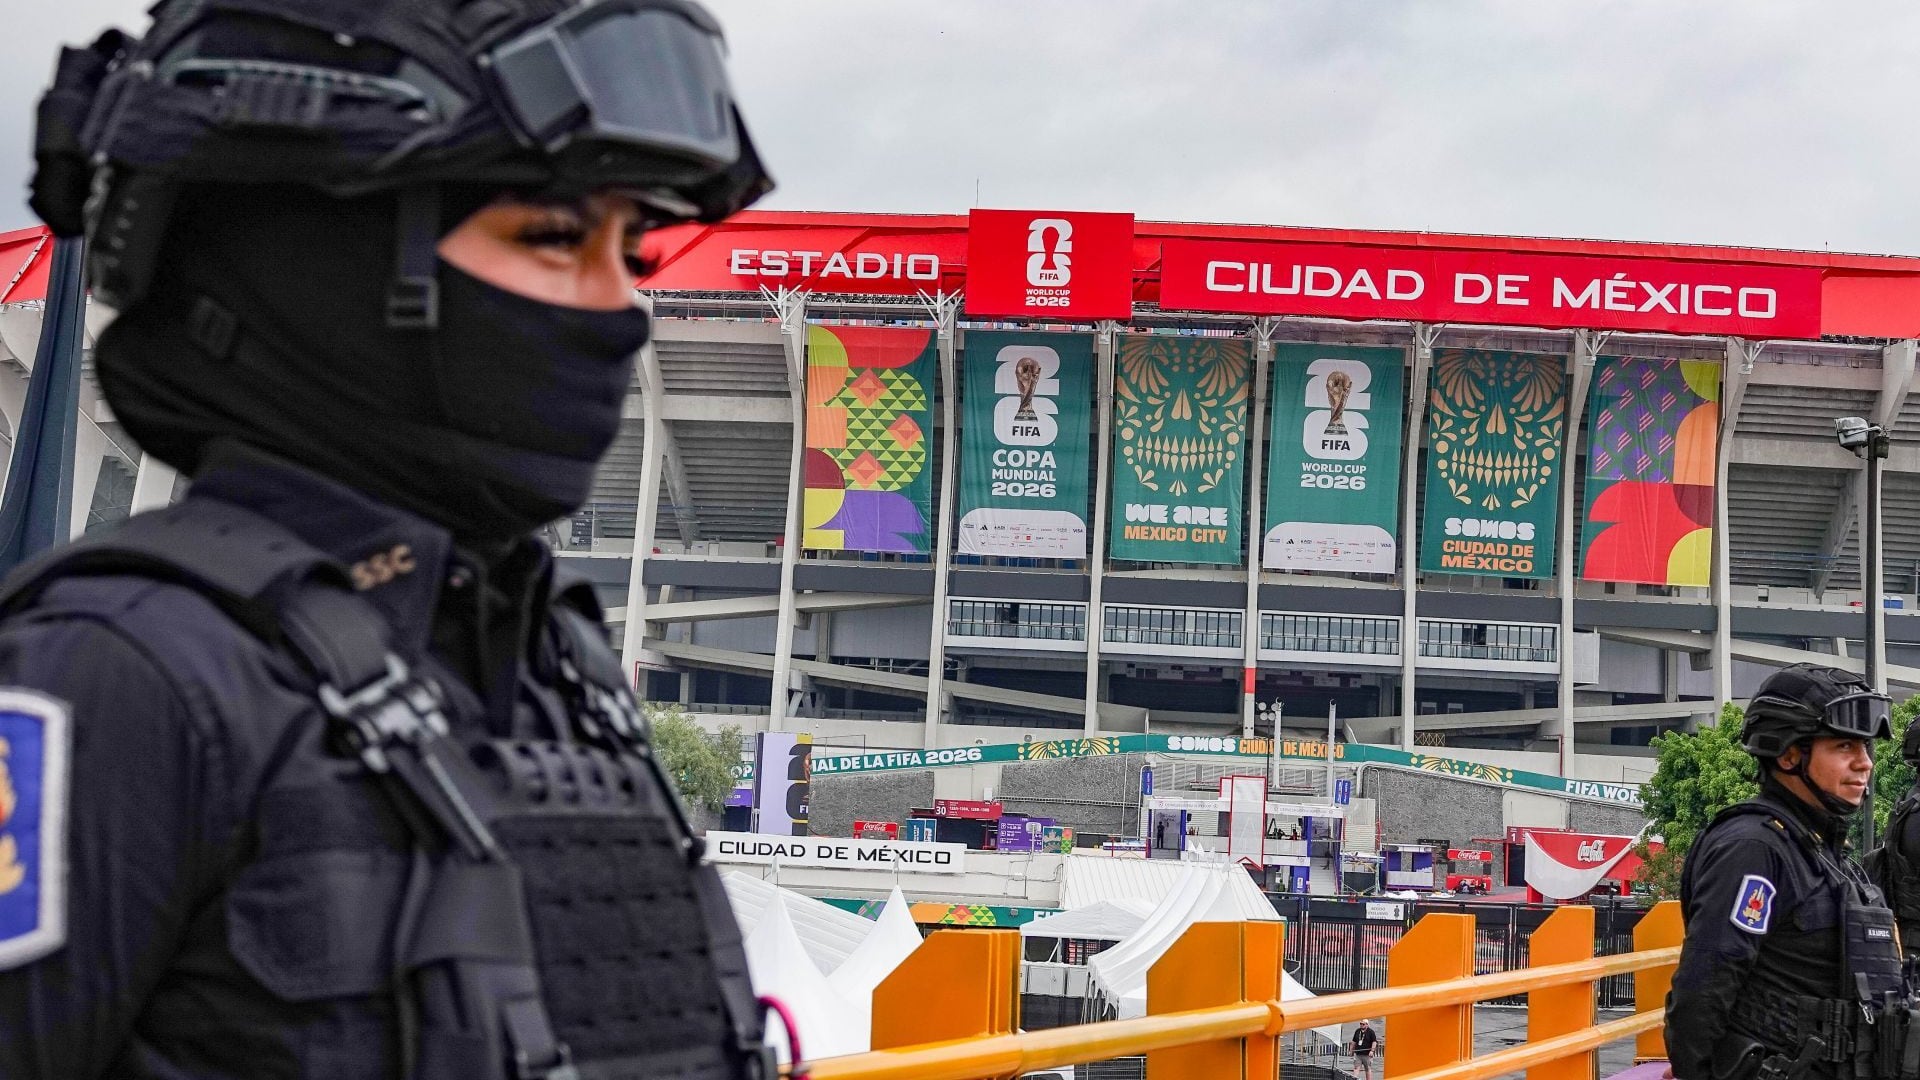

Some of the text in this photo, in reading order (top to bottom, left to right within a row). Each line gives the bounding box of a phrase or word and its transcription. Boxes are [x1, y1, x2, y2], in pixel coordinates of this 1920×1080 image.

[730, 249, 939, 280] ESTADIO
[1206, 261, 1777, 319] CIUDAD DE MÉXICO
[1025, 296, 1071, 307] 2026
[1012, 426, 1041, 437] FIFA
[1321, 440, 1350, 451] FIFA
[992, 449, 1056, 469] COPA
[992, 469, 1056, 482] MUNDIAL
[1301, 463, 1367, 474] WORLD CUP
[992, 482, 1056, 498] 2026
[1301, 473, 1366, 491] 2026
[1125, 503, 1228, 527] WE ARE
[1124, 525, 1227, 544] MEXICO CITY
[1444, 517, 1535, 540] SOMOS
[1443, 540, 1534, 558] CIUDAD DE
[1441, 553, 1533, 573] MÉXICO
[1167, 736, 1344, 759] SOMOS CIUDA DE MÉXIO
[840, 756, 861, 771] DE
[863, 754, 886, 769] LA
[887, 752, 922, 767] FIFA
[925, 748, 982, 764] 2026
[1565, 780, 1600, 797] FIFA
[936, 806, 947, 815] 30
[1511, 833, 1516, 842] 1
[719, 841, 951, 864] CIUDAD DE MÉXICO
